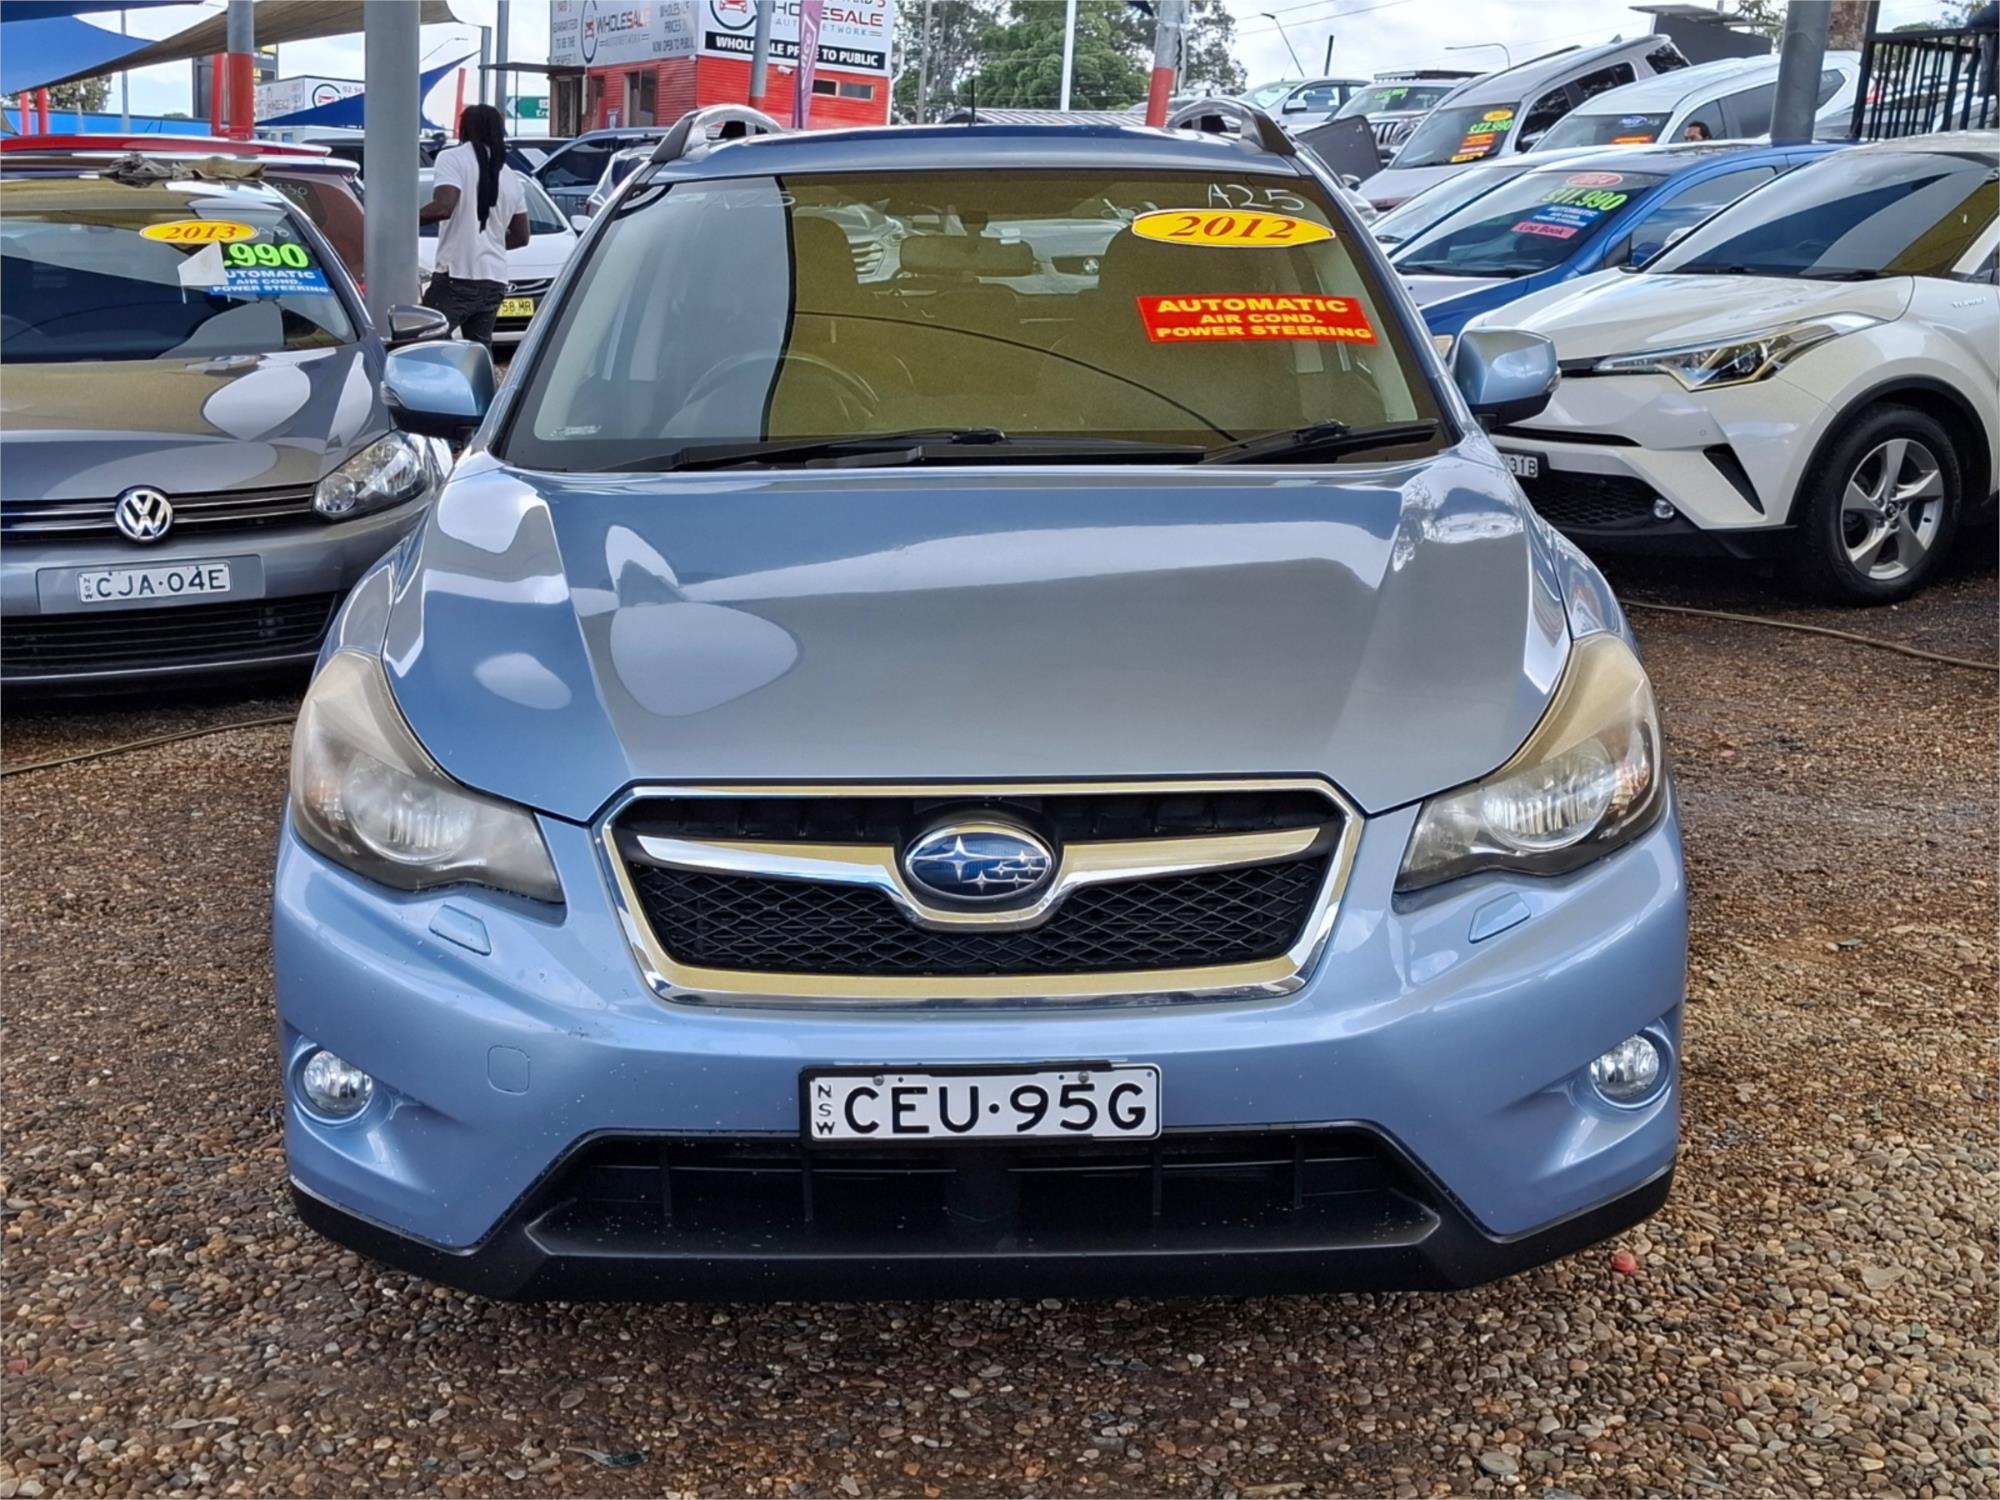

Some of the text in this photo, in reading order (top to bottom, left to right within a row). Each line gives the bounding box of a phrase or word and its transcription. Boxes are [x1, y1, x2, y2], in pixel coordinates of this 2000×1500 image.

[596, 9, 652, 34] WHOLESAL
[772, 1, 884, 27] HOESALE
[822, 25, 867, 36] ETWORK
[822, 48, 836, 61] TO
[839, 50, 879, 67] PUBLIC
[1207, 183, 1305, 211] A25
[165, 226, 237, 240] 2013
[1168, 215, 1297, 239] 2012
[223, 243, 309, 268] .990
[225, 270, 316, 279] UTOMATIC
[265, 285, 329, 293] STEERING
[1157, 298, 1349, 313] AUTOMATIC
[1200, 313, 1323, 324] AIR COND.
[1156, 325, 1372, 338] POWER STEERING
[816, 1084, 836, 1135] NSW
